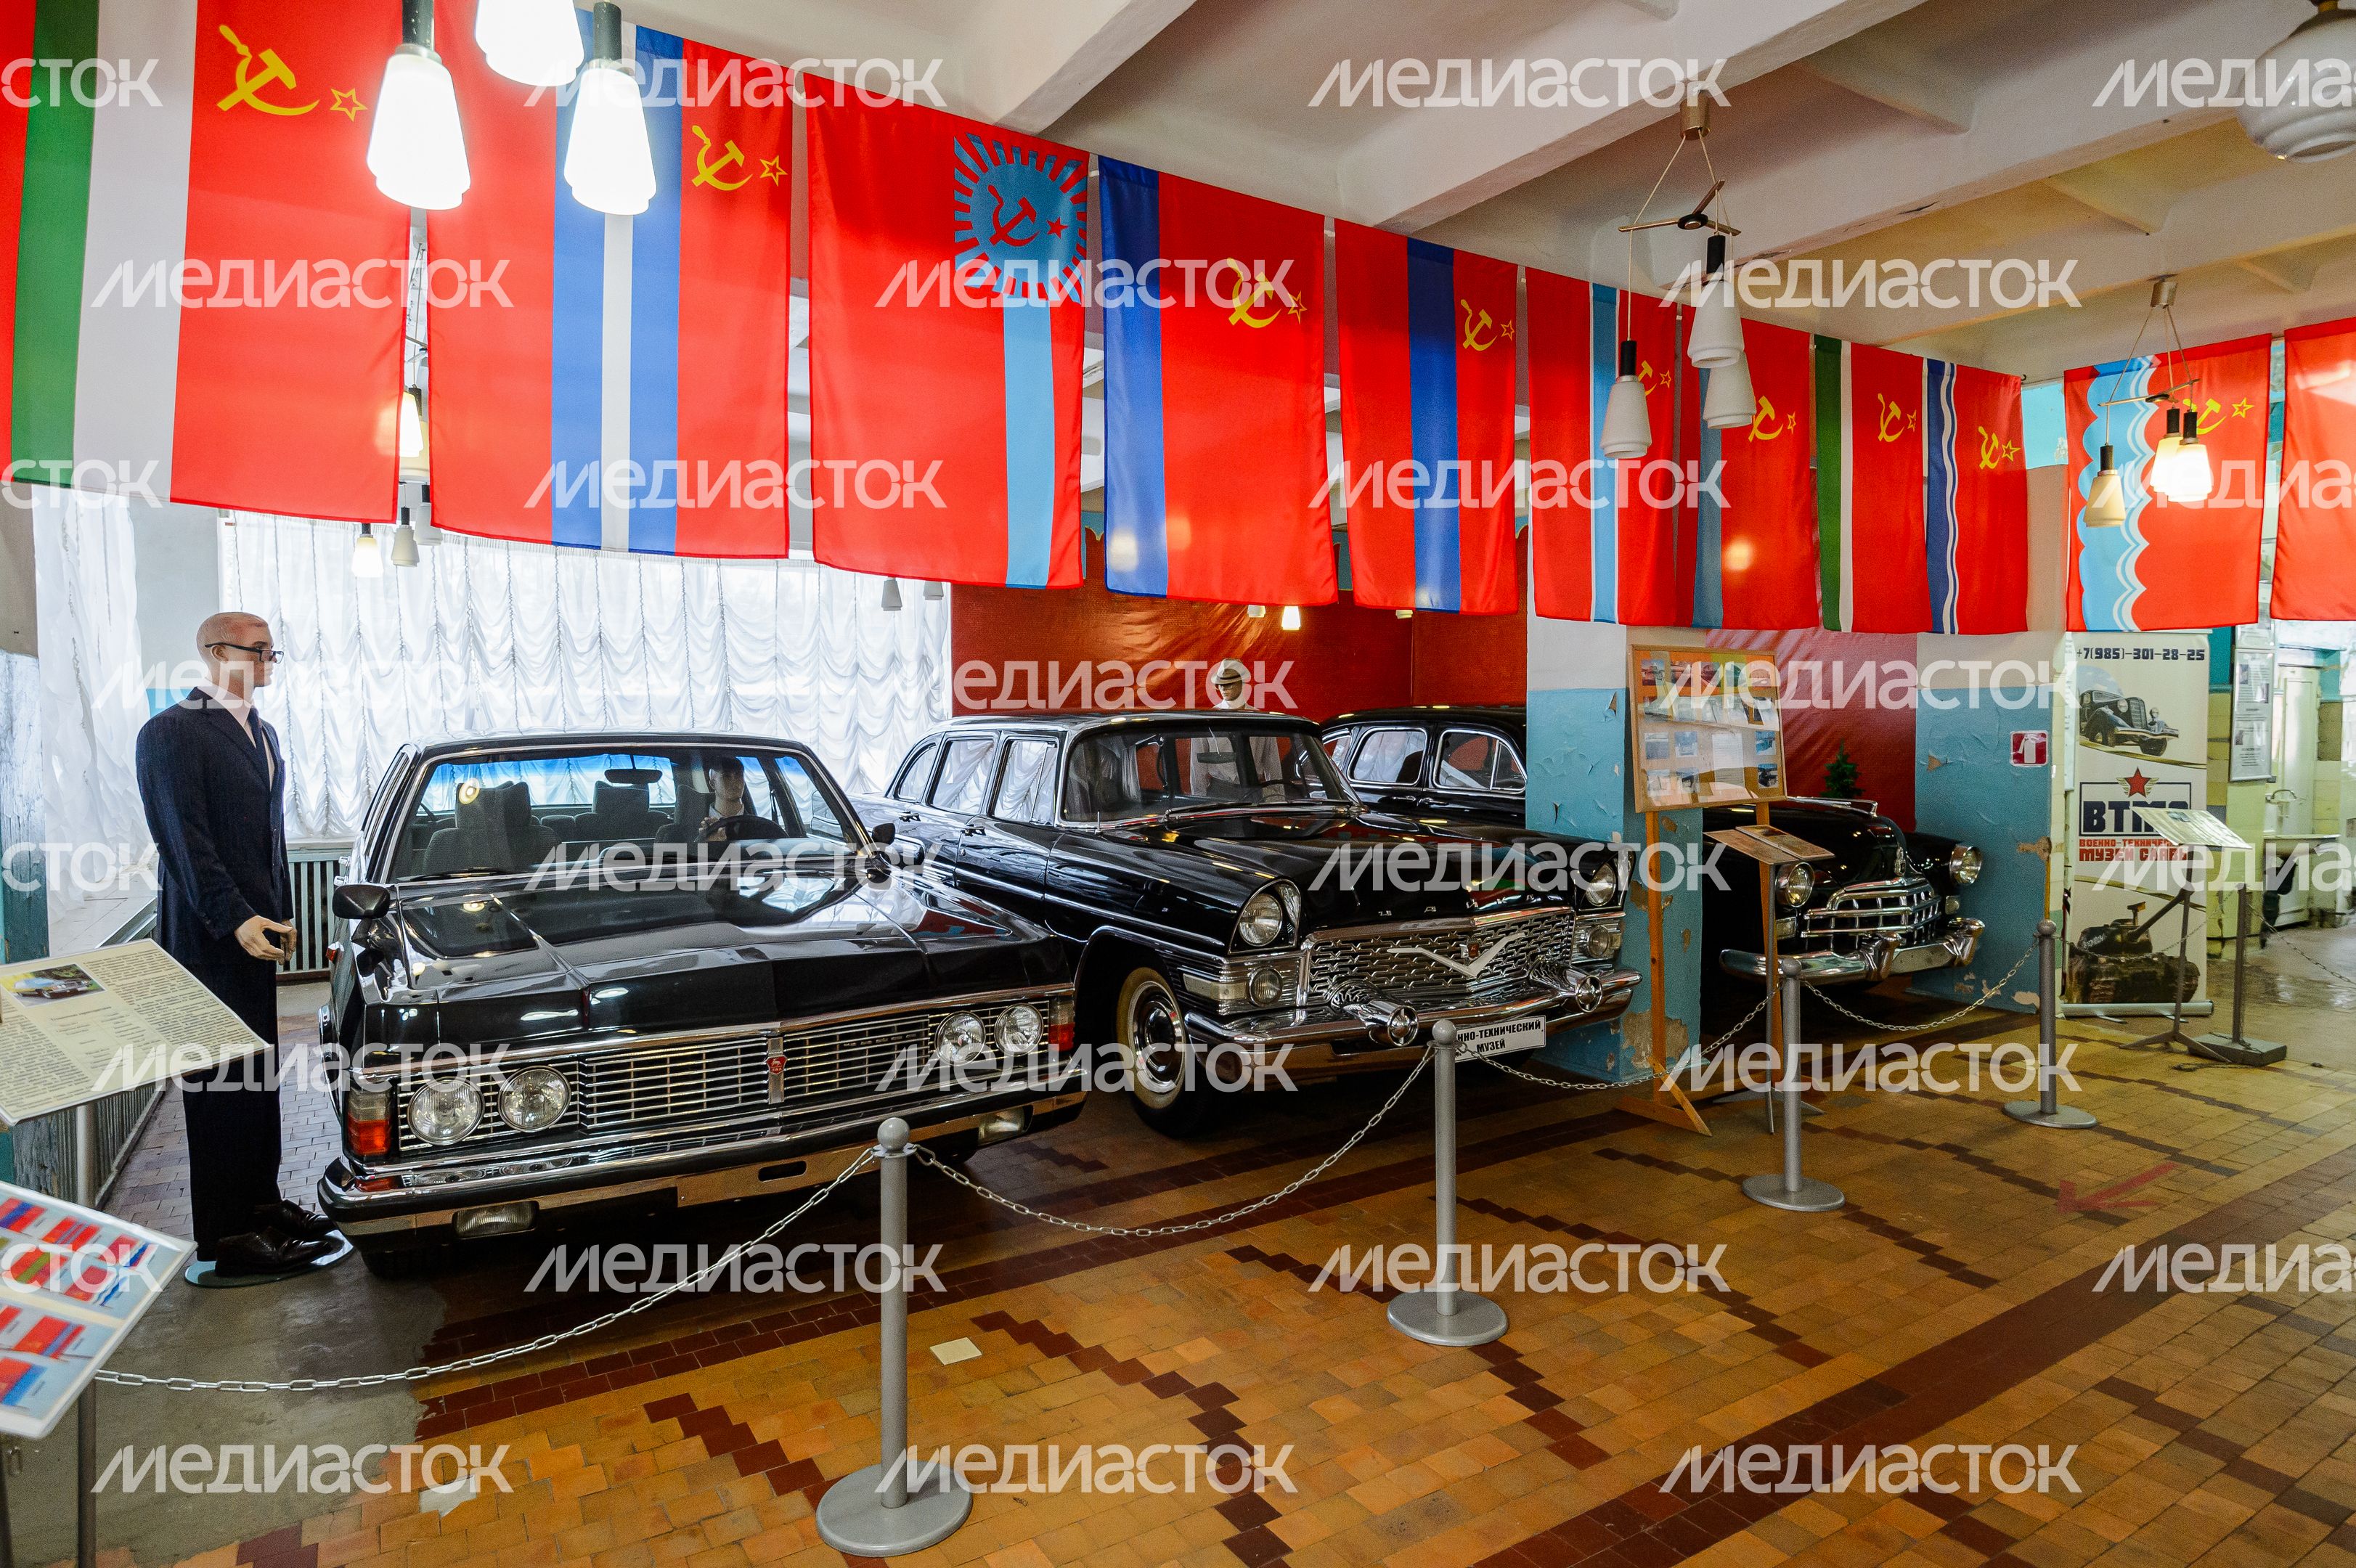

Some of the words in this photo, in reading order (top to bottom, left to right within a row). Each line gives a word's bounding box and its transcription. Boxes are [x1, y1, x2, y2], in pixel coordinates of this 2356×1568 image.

[2076, 648, 2205, 661] +7(985)-301-28-25
[1457, 1019, 1541, 1042] ННО-ТЕХНИЧЕСКИЙ
[1477, 1039, 1506, 1053] МУЗЕЙ
